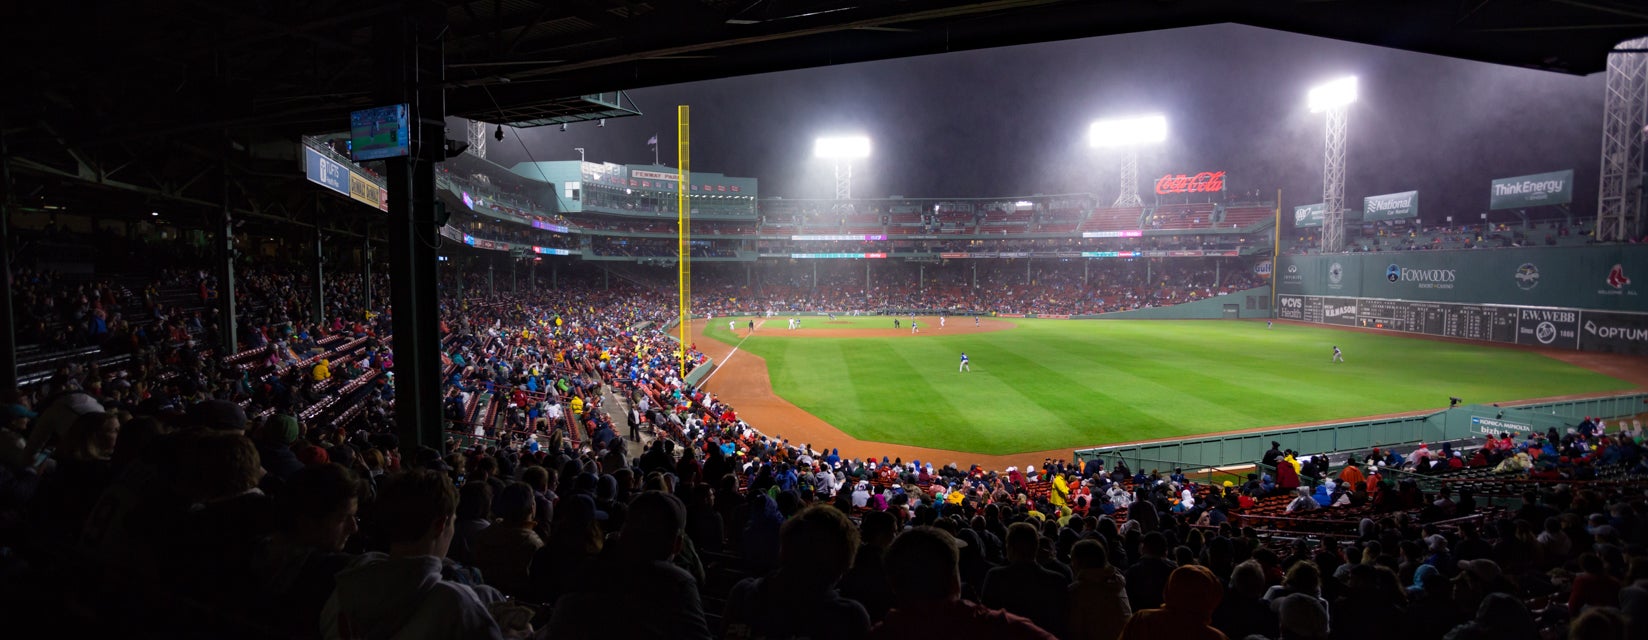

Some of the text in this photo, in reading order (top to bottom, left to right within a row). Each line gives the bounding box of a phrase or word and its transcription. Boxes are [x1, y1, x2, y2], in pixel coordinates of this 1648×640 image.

[1376, 197, 1411, 211] National
[1401, 267, 1456, 282] FOXWOODS
[1287, 297, 1302, 308] CVS
[1281, 307, 1302, 319] Health
[1542, 311, 1576, 323] WEBB
[1599, 326, 1648, 341] OPTUM
[1480, 419, 1531, 432] KONICA MINOLTA
